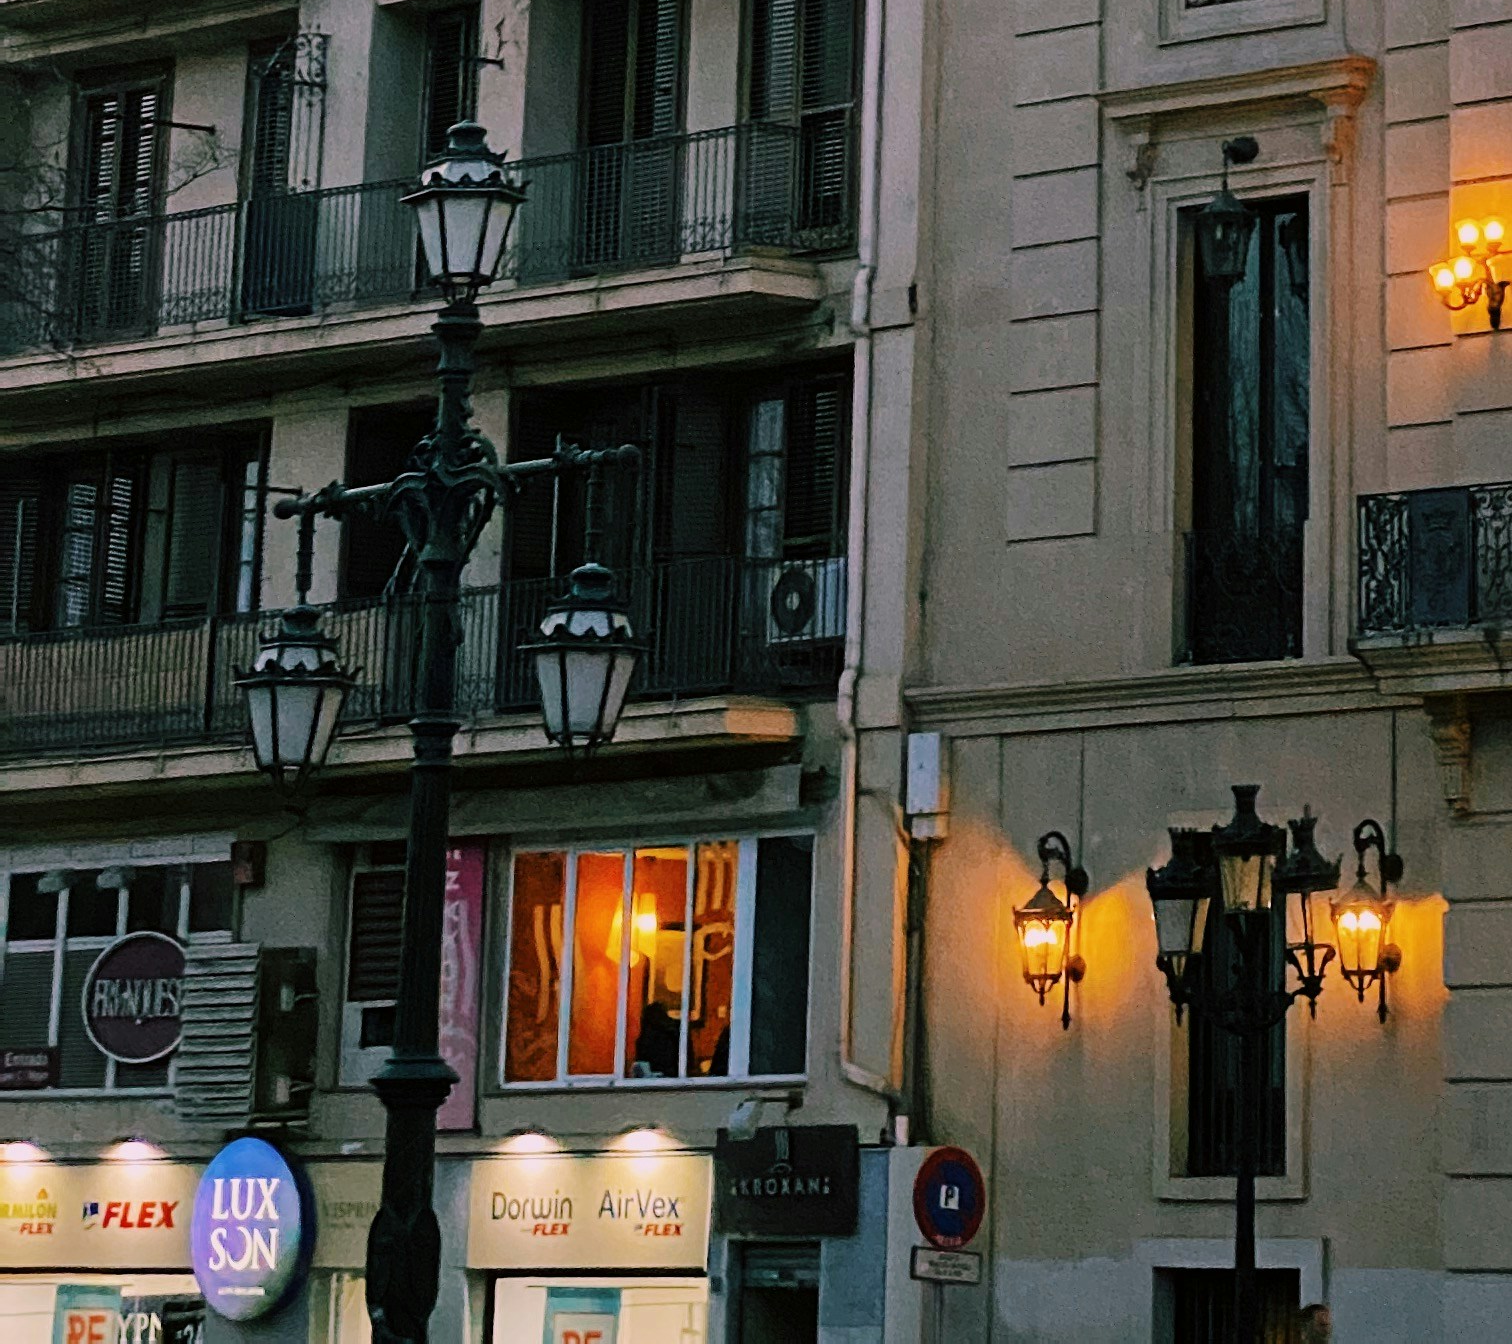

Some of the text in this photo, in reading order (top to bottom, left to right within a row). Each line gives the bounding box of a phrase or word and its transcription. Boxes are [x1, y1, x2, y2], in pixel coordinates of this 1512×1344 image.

[212, 1178, 280, 1220] LUX
[492, 1189, 573, 1220] Dorwin
[598, 1189, 680, 1219] AirVex
[102, 1201, 180, 1229] FLEX
[532, 1223, 571, 1236] FLEX
[643, 1223, 684, 1236] FLEX
